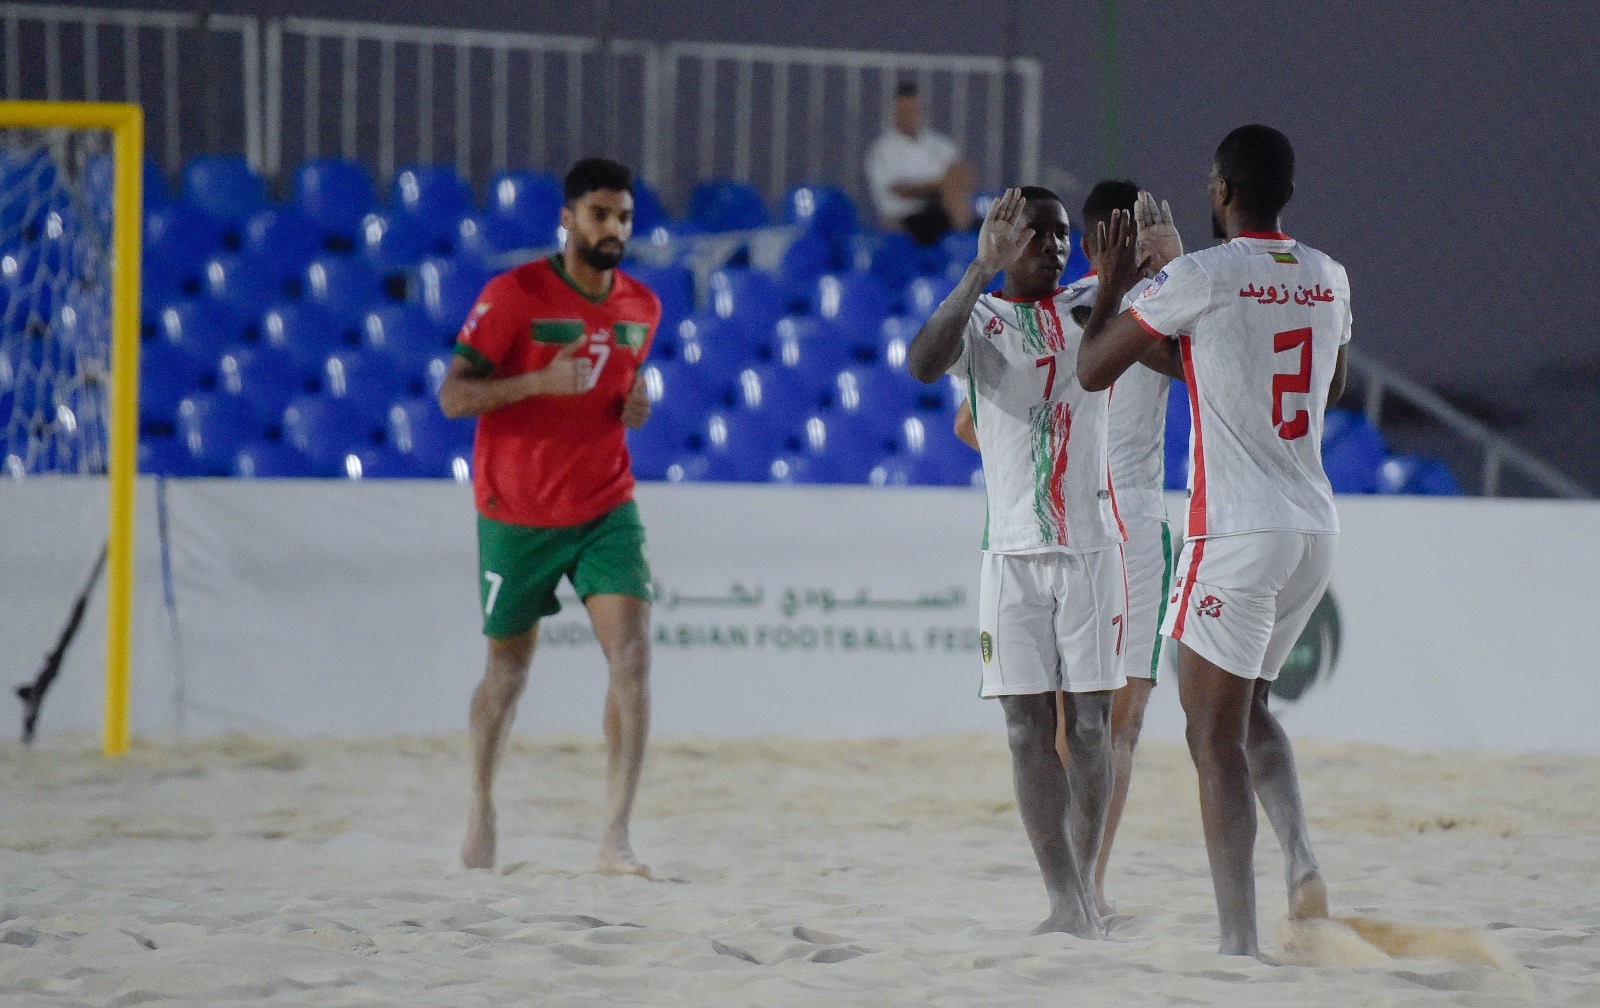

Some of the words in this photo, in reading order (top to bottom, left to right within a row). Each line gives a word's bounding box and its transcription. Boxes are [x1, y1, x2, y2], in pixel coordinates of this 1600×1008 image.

[589, 344, 611, 388] 7
[1036, 356, 1056, 400] 7
[1272, 327, 1312, 440] 2
[485, 570, 503, 615] 7
[654, 625, 749, 647] ABIAN
[757, 626, 914, 650] FOOTBALL
[1112, 614, 1123, 655] 7
